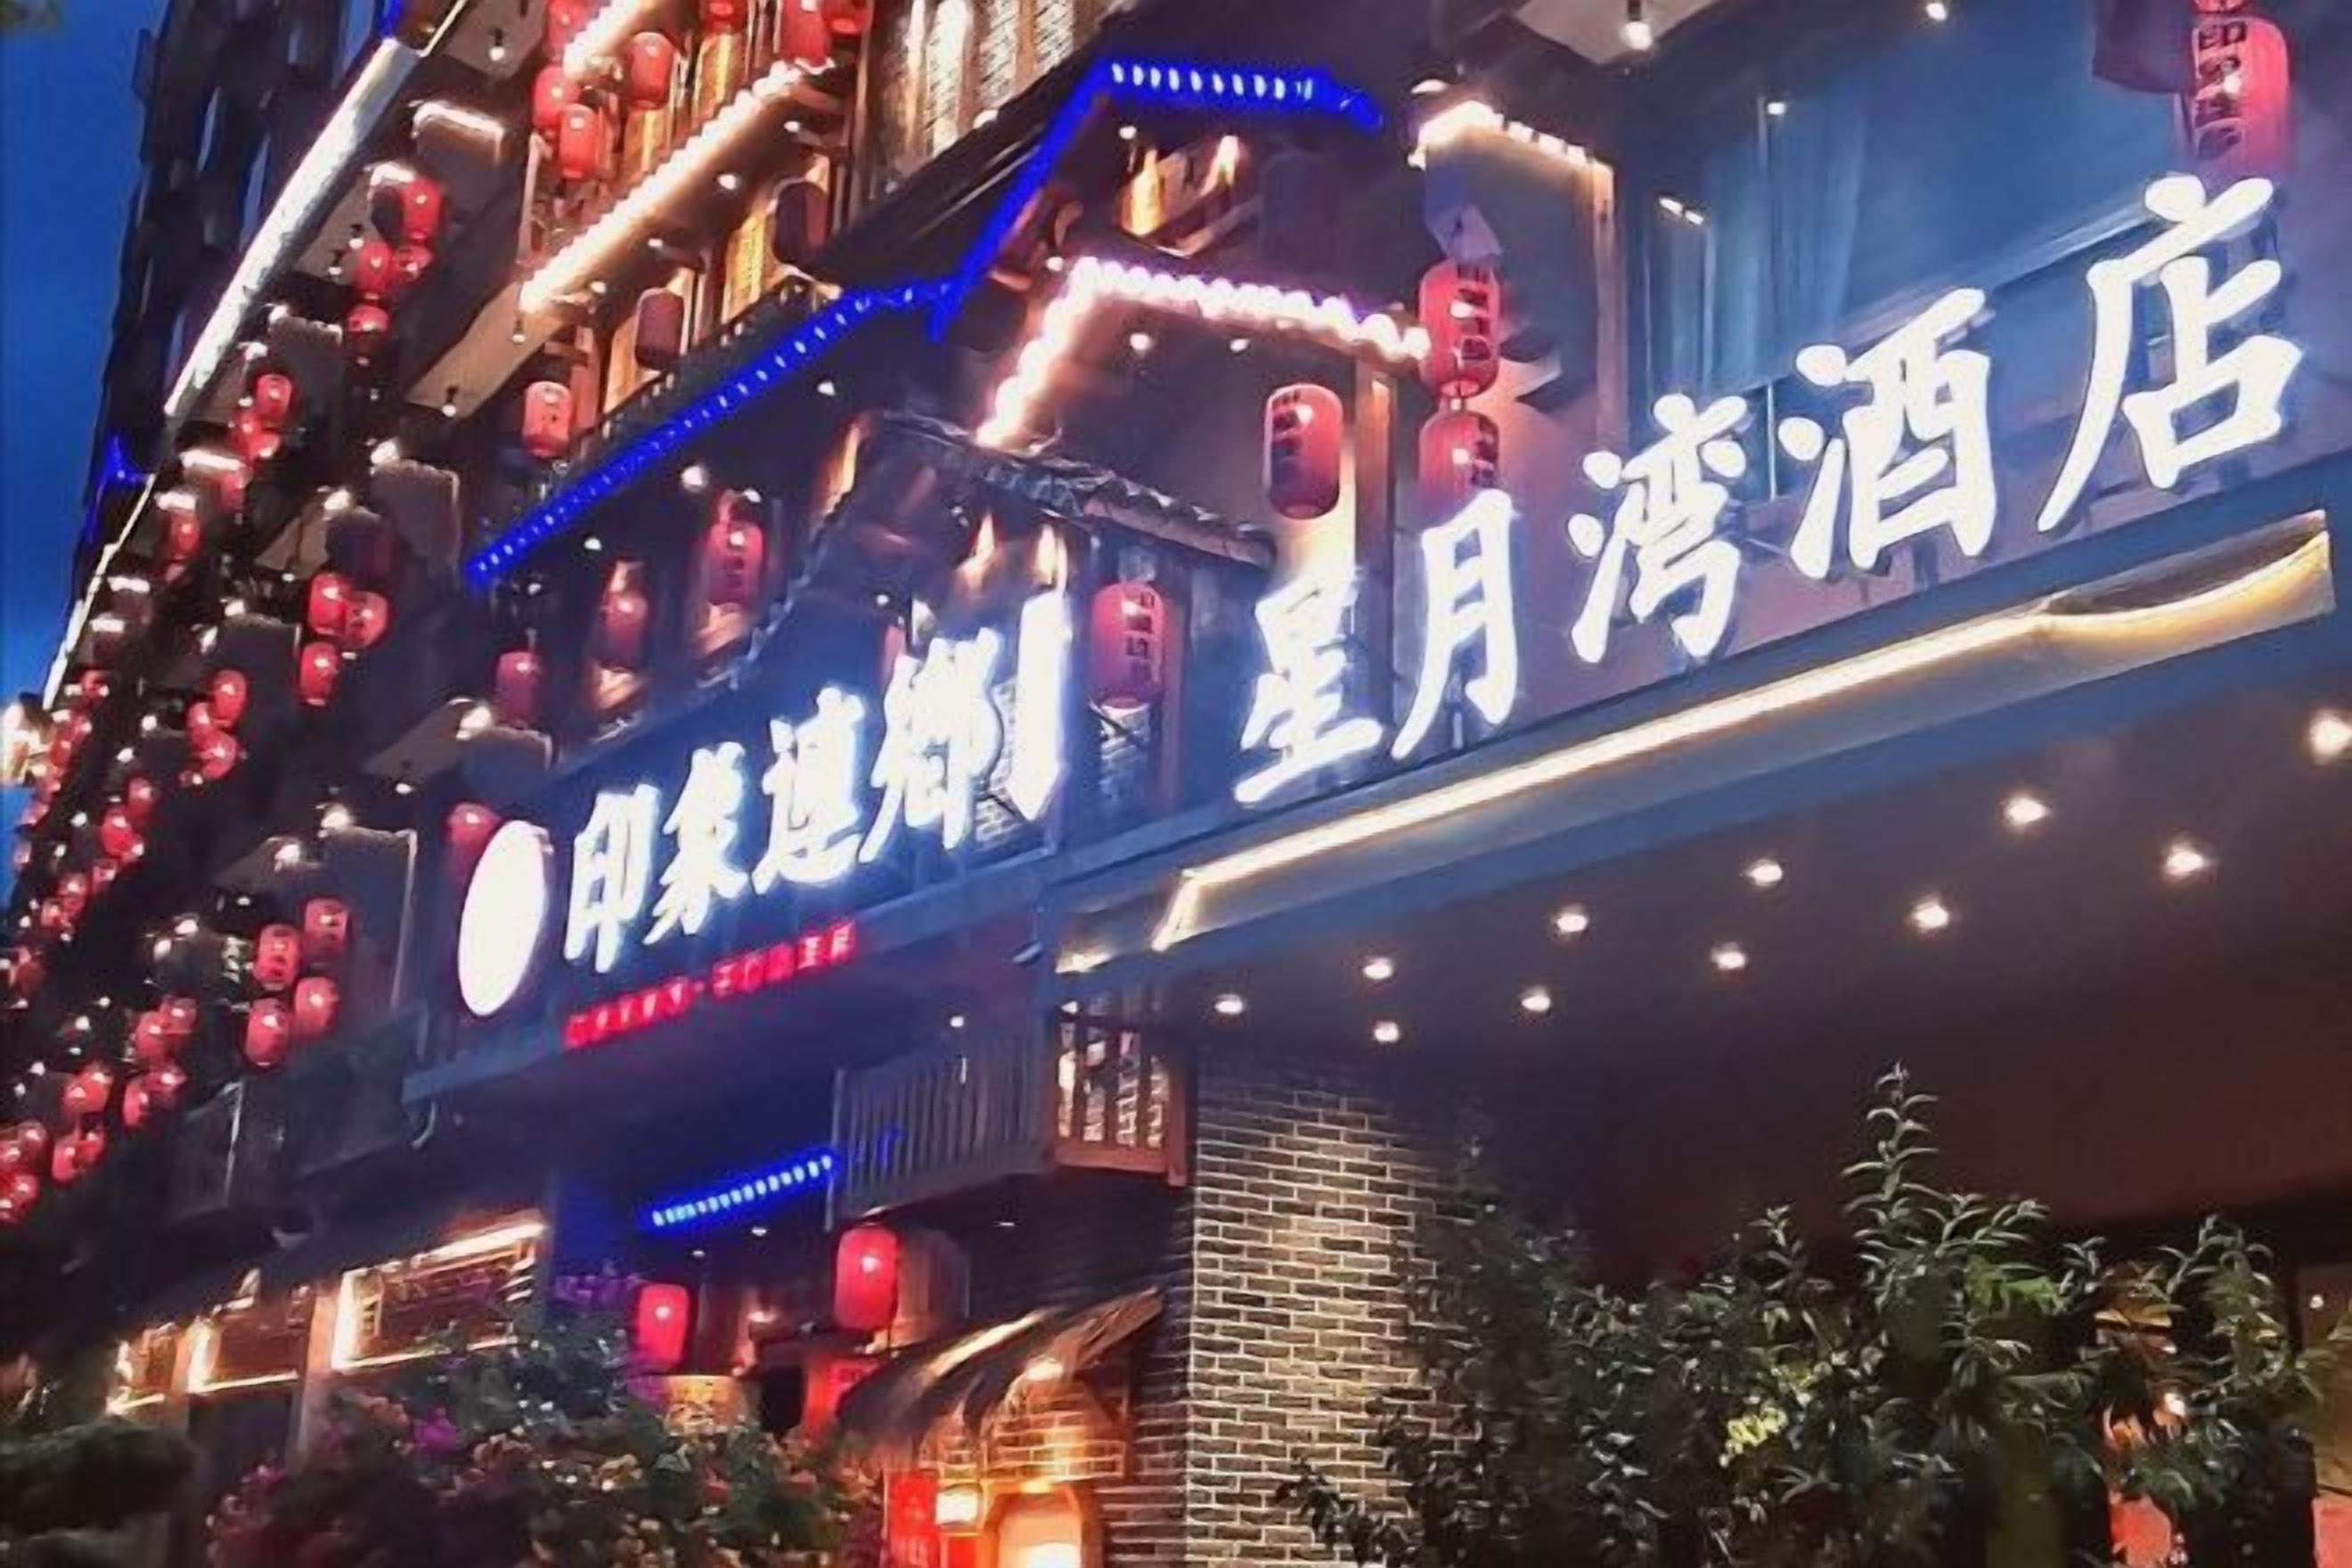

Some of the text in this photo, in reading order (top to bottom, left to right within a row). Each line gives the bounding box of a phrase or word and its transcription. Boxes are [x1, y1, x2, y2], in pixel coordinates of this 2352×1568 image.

[1235, 175, 2302, 804] 星月湾酒店
